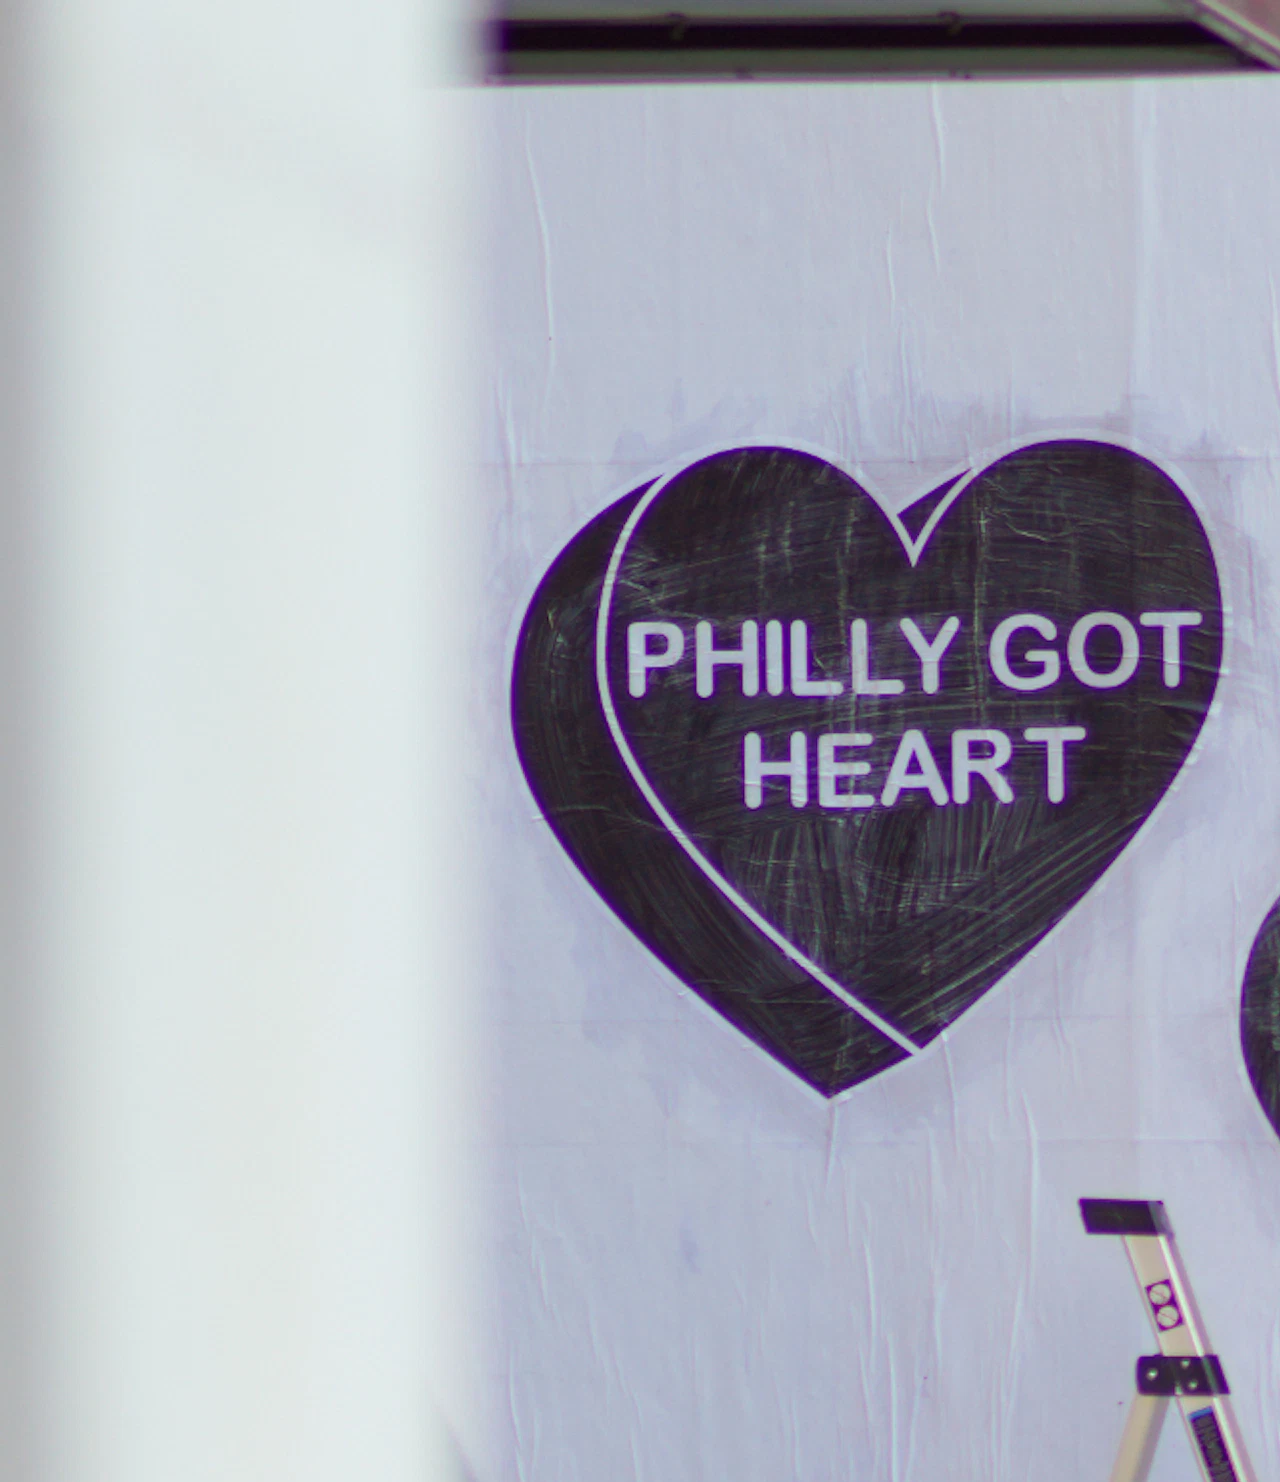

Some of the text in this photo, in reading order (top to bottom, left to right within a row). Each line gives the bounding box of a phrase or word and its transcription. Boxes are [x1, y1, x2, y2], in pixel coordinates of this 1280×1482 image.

[628, 612, 1202, 698] PHILLY GOT
[744, 727, 1086, 809] HEART
